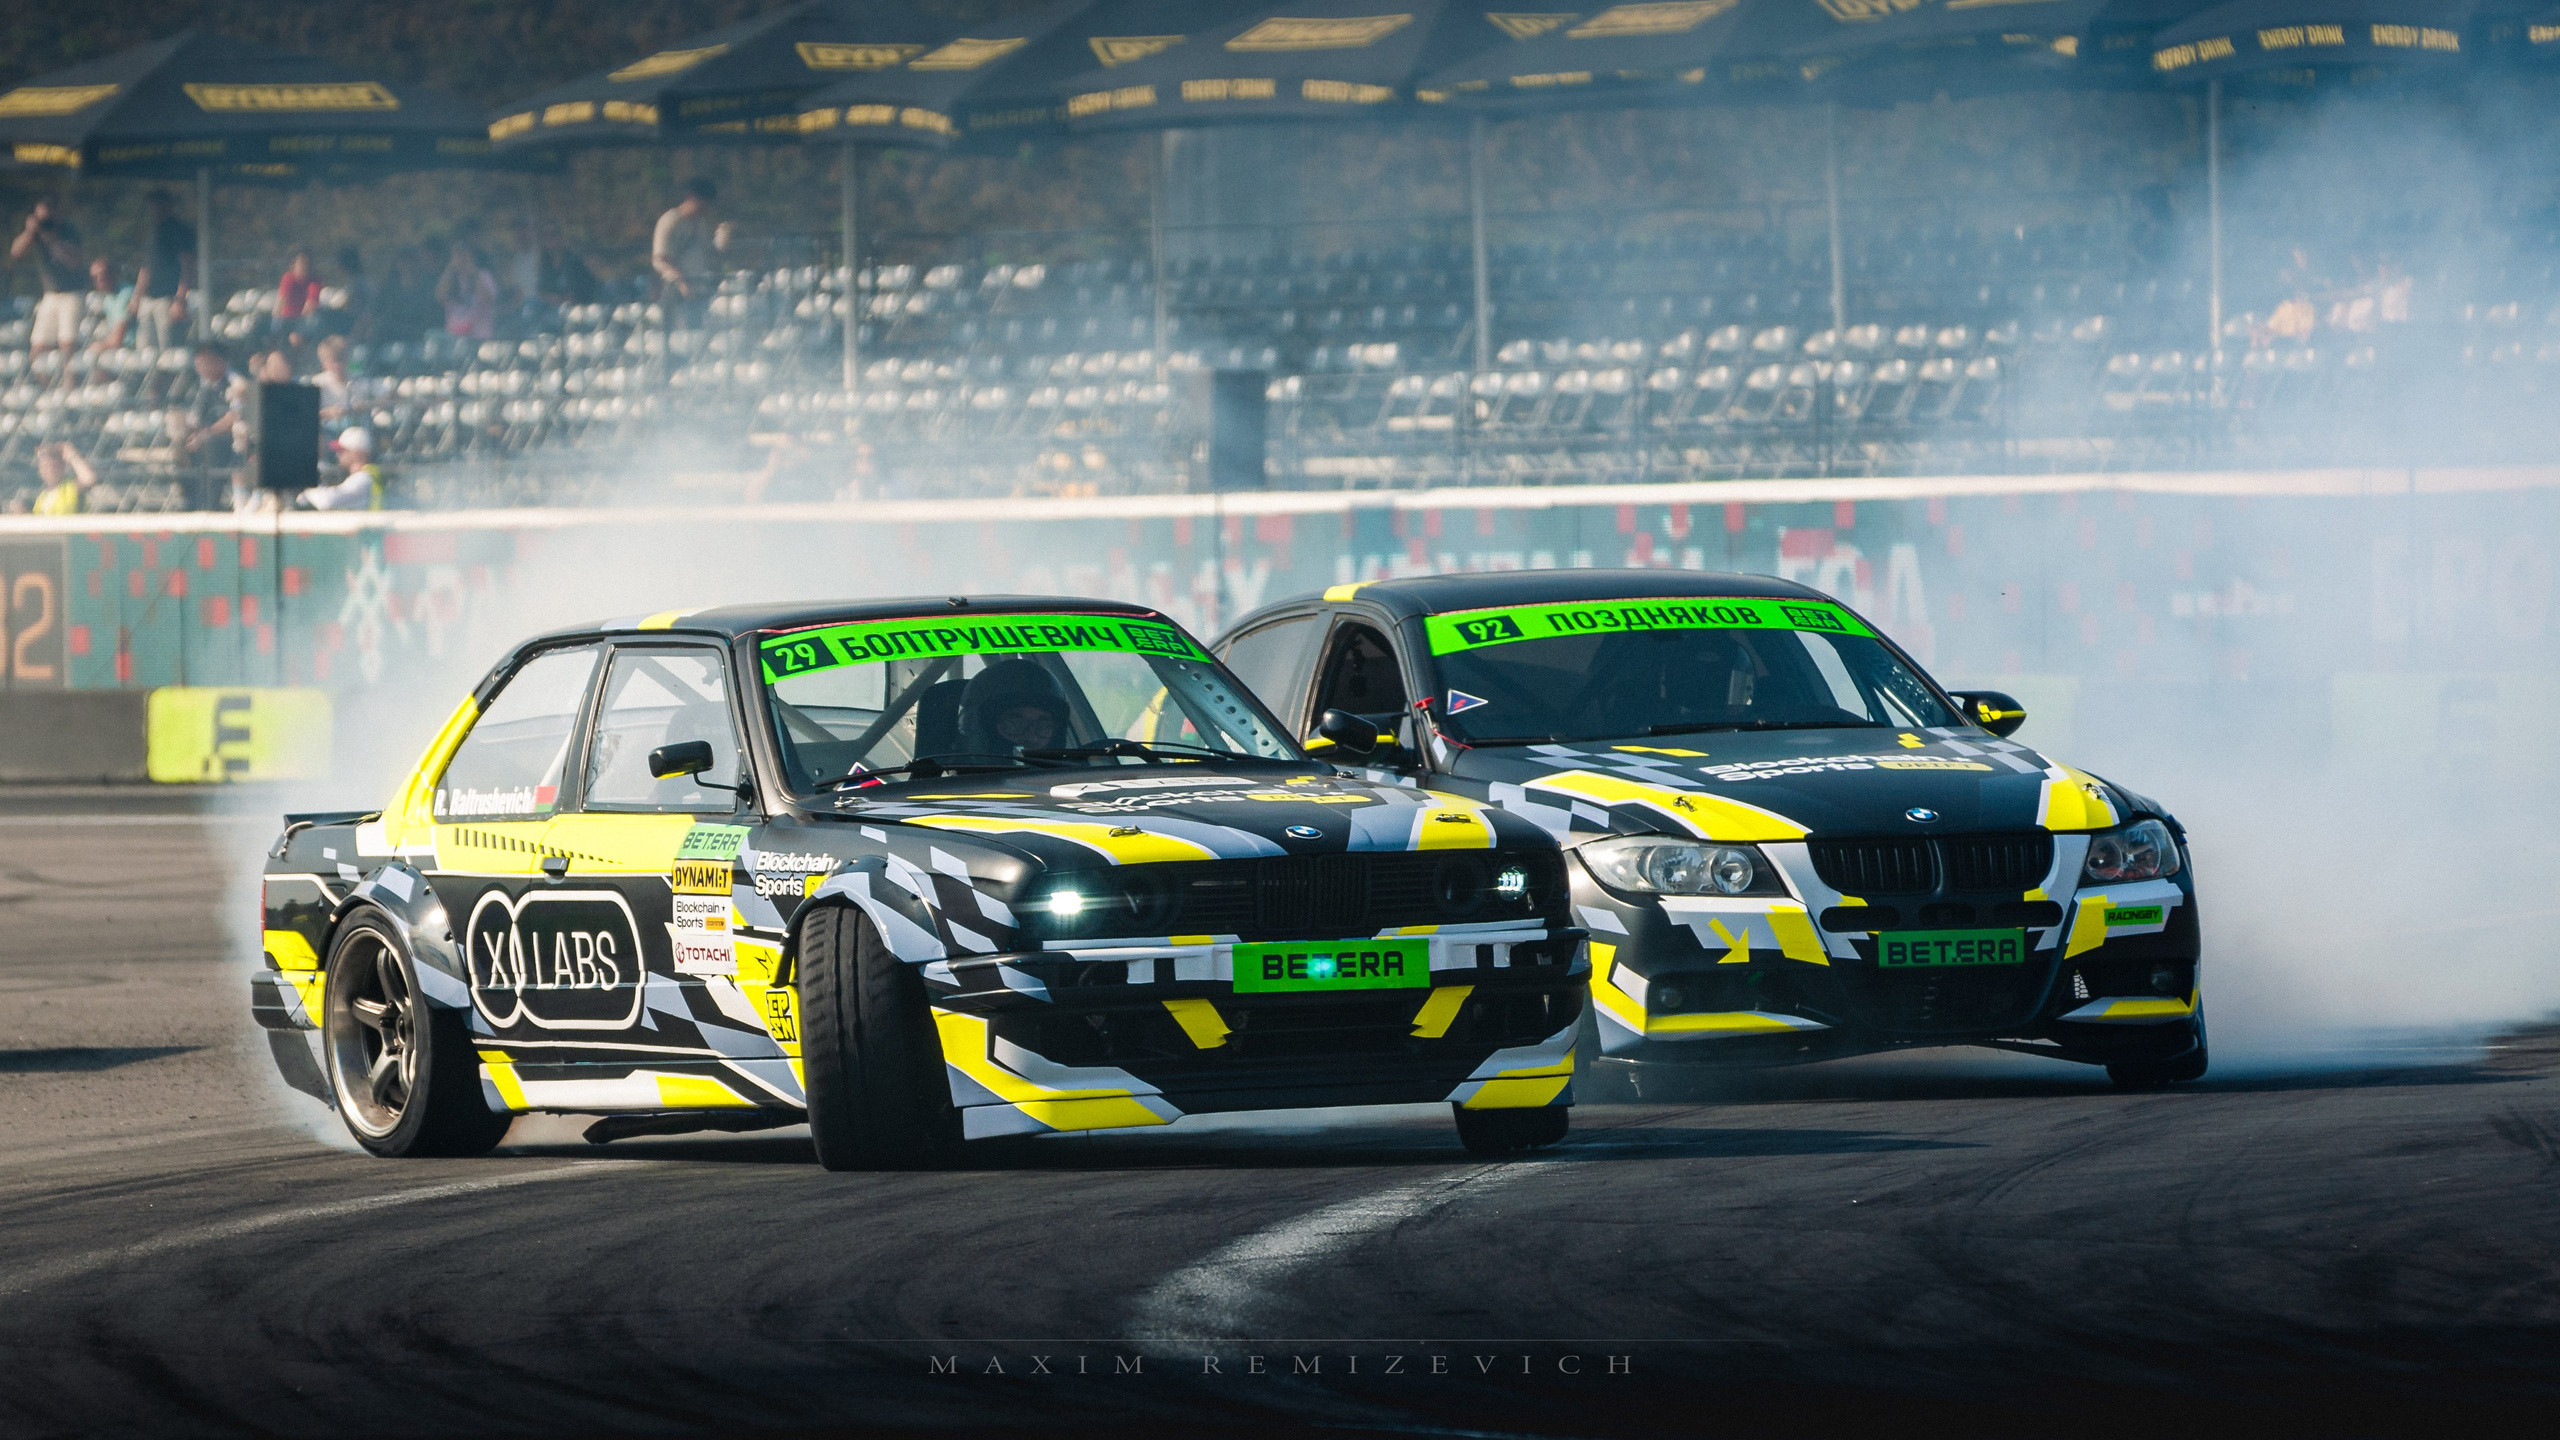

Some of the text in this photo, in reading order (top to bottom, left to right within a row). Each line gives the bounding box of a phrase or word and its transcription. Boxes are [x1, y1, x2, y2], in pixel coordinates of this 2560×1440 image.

[1467, 619, 1511, 642] 92
[1546, 606, 1763, 632] ПОЗДНЯКОВ
[838, 625, 1124, 661] БОЛТРУШЕВИЧ
[774, 642, 816, 673] 29
[433, 788, 448, 816] R.
[755, 851, 835, 872] Blockchain
[755, 873, 804, 900] Sports
[676, 901, 720, 913] Blockchain
[676, 915, 704, 930] Sports
[532, 931, 620, 991] LABS
[686, 947, 731, 962] TOTACHI
